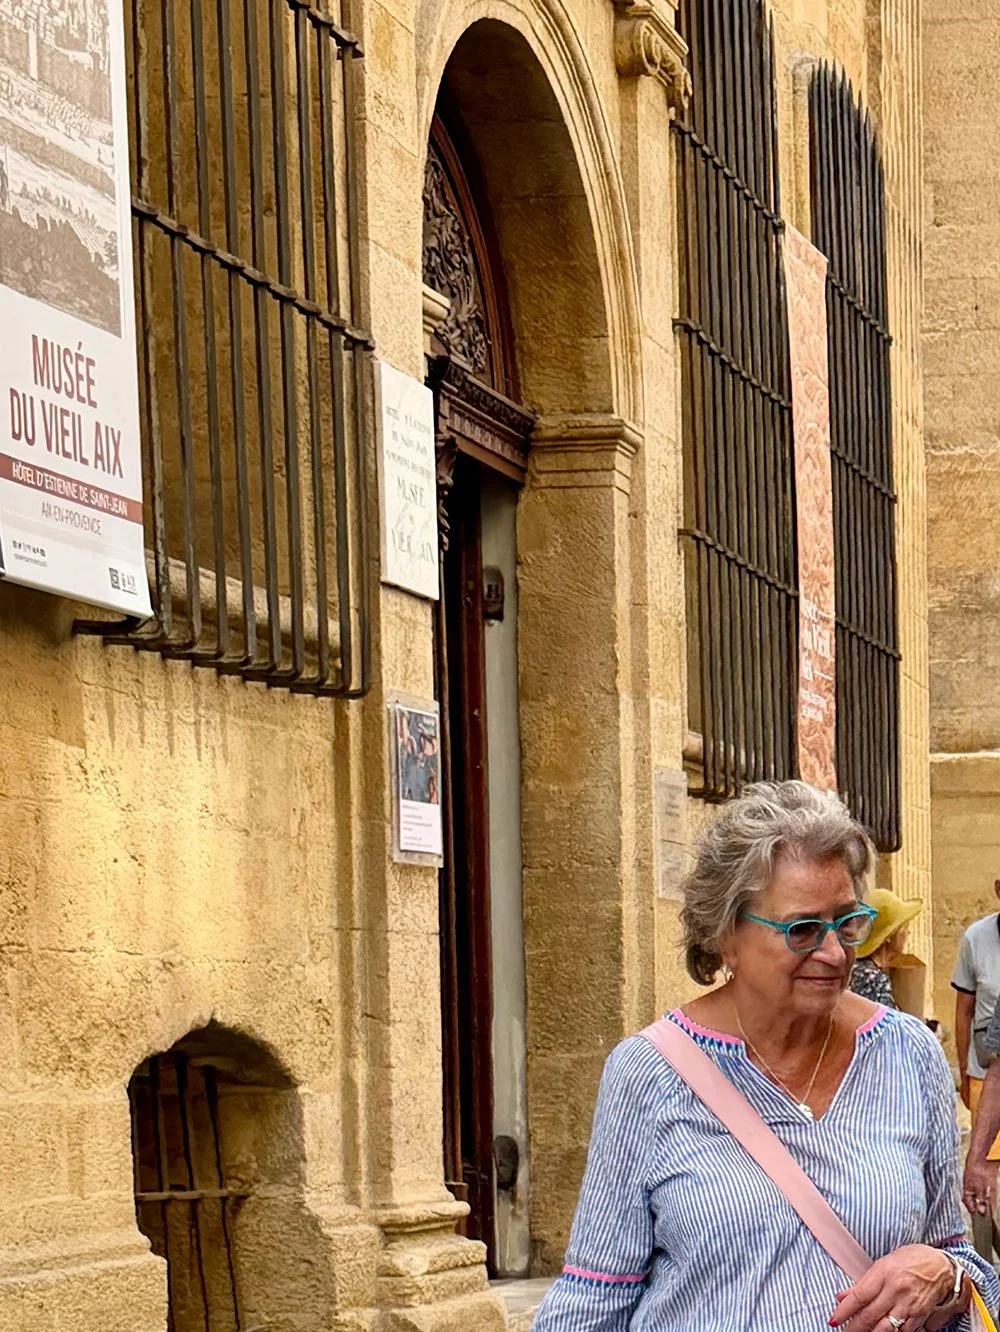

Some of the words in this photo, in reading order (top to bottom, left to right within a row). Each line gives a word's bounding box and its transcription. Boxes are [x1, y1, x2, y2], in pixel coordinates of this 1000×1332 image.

[32, 334, 97, 409] MUSÉE
[10, 387, 36, 447] DU
[40, 399, 89, 466] VIEIL
[94, 421, 124, 479] AIX
[12, 461, 35, 485] HÔTEL
[36, 470, 78, 500] D'ESTIENNE
[78, 485, 89, 503] DE
[90, 489, 128, 517] SAINT-JEAN
